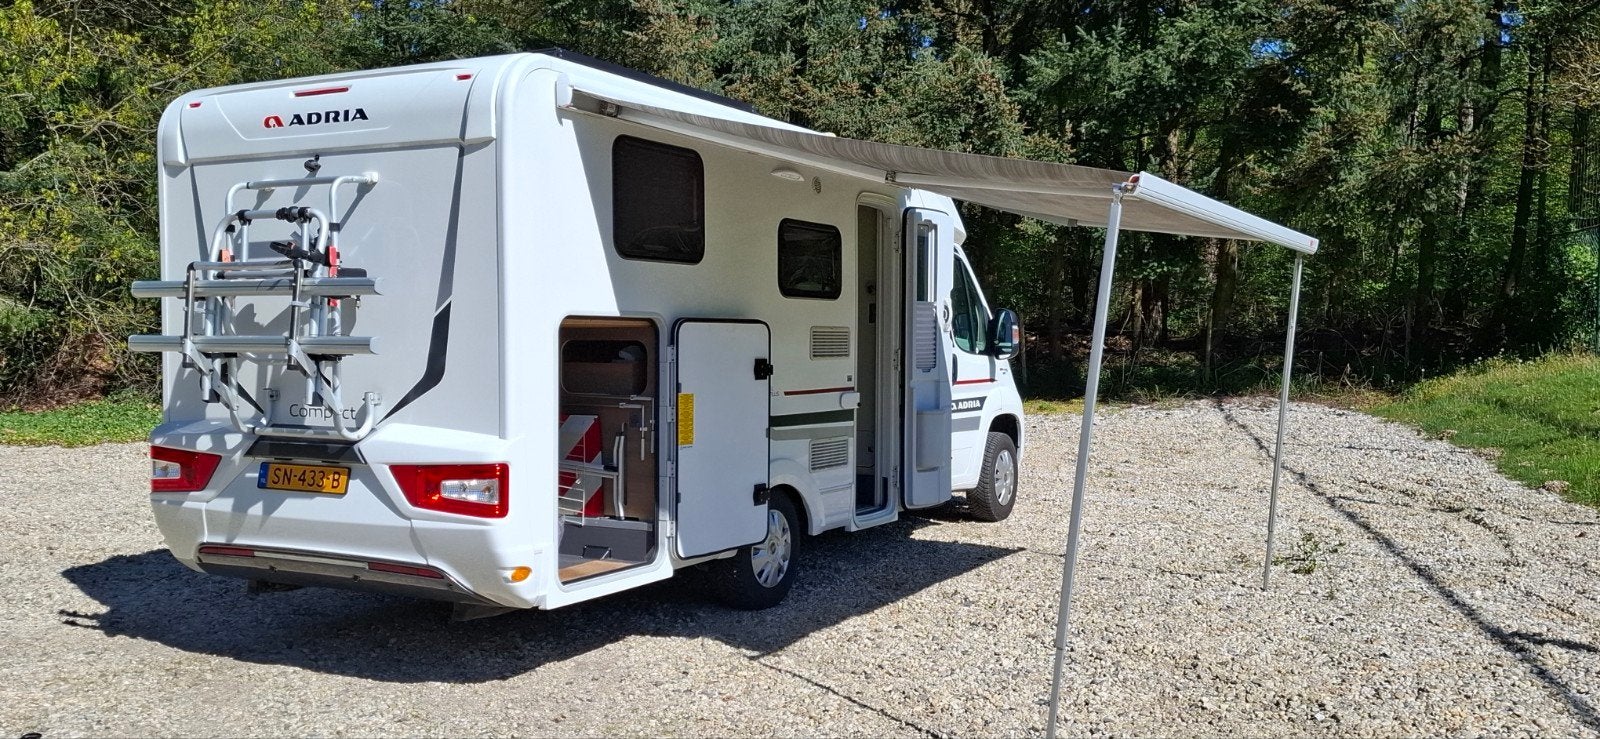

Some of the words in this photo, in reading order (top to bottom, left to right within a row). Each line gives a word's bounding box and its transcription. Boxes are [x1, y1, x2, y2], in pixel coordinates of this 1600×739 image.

[289, 108, 369, 126] ADRIA
[289, 404, 356, 421] Compct
[957, 399, 981, 410] ADRIA
[271, 467, 341, 489] SN-433-B
